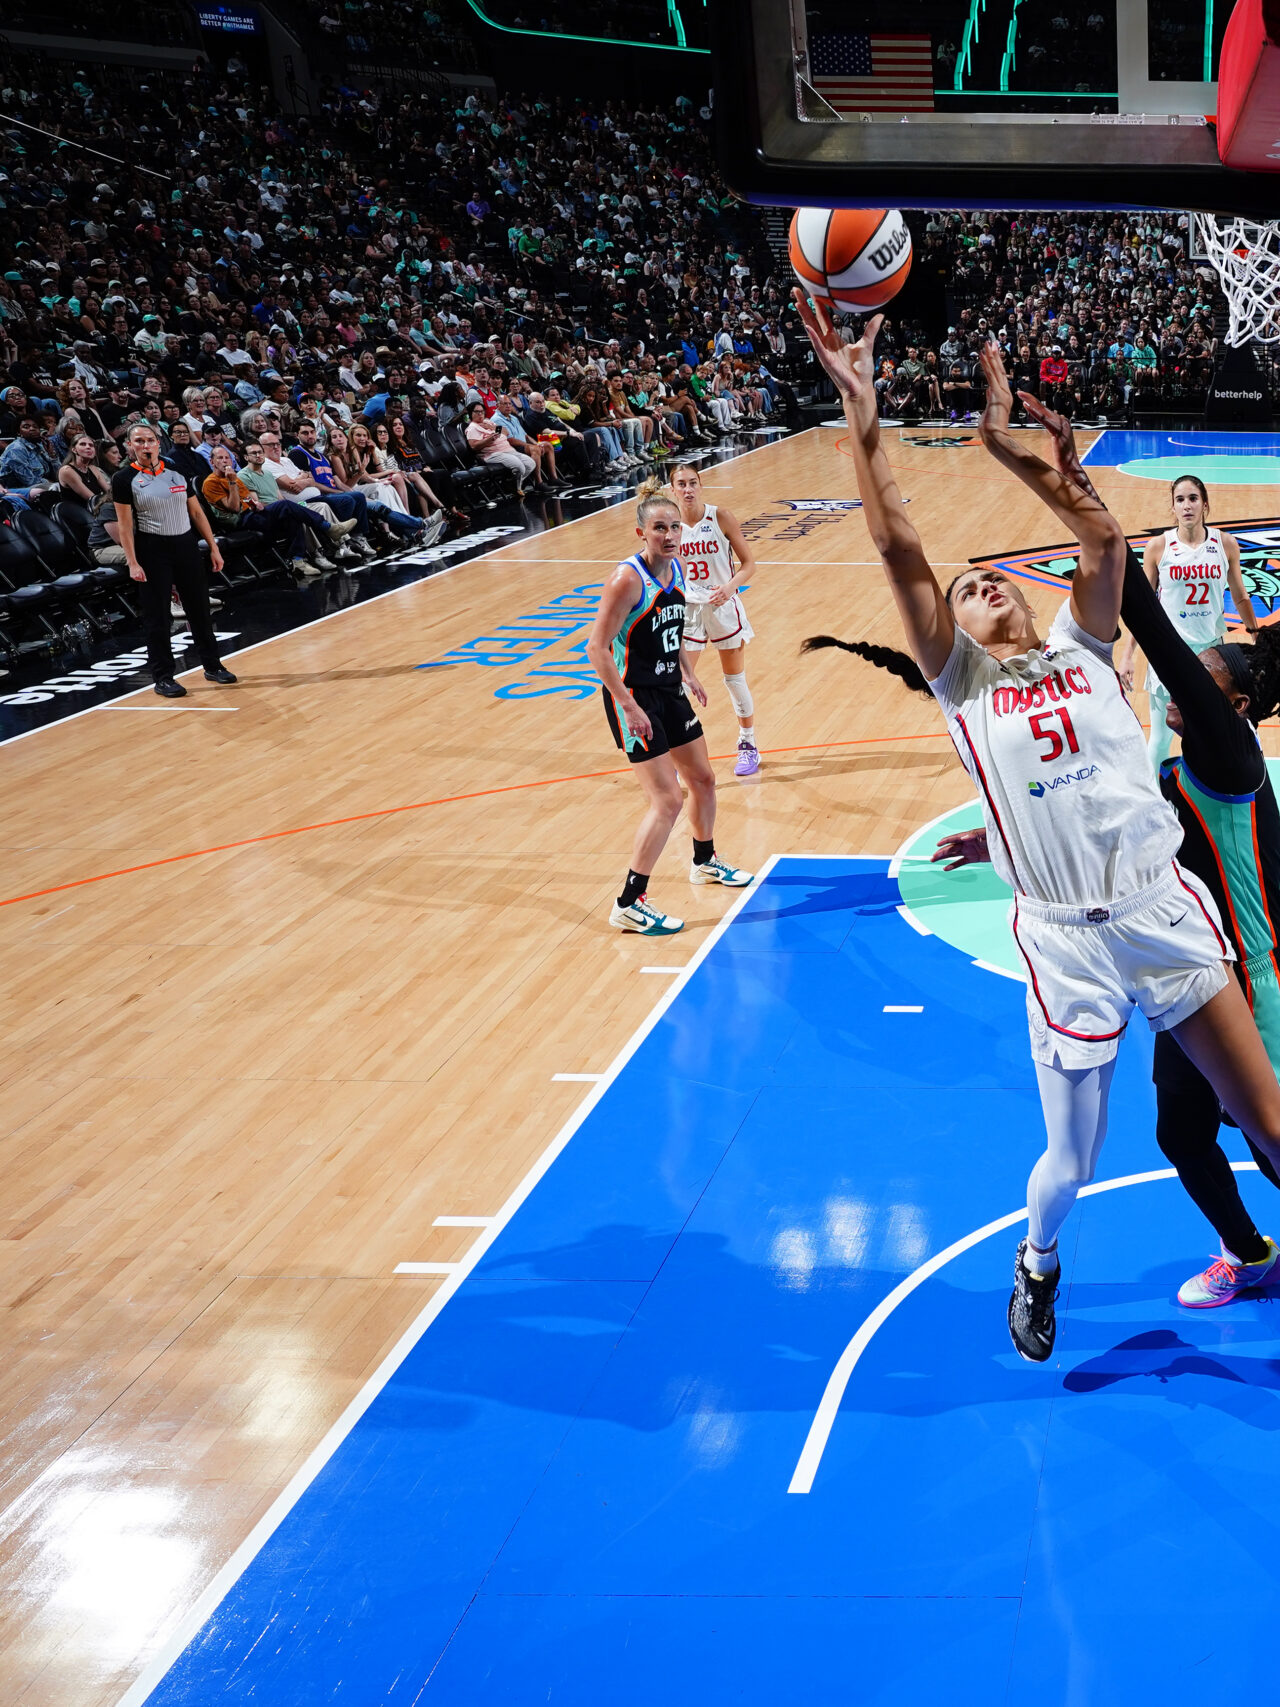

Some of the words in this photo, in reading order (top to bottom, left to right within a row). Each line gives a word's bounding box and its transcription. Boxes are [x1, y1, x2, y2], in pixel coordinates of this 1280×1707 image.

[867, 222, 909, 271] Wilso
[1214, 389, 1263, 400] betterhelp
[687, 560, 710, 581] 33
[1185, 583, 1210, 605] 22
[662, 625, 680, 653] 13
[1028, 706, 1081, 763] 51
[1044, 764, 1102, 791] VANDA
